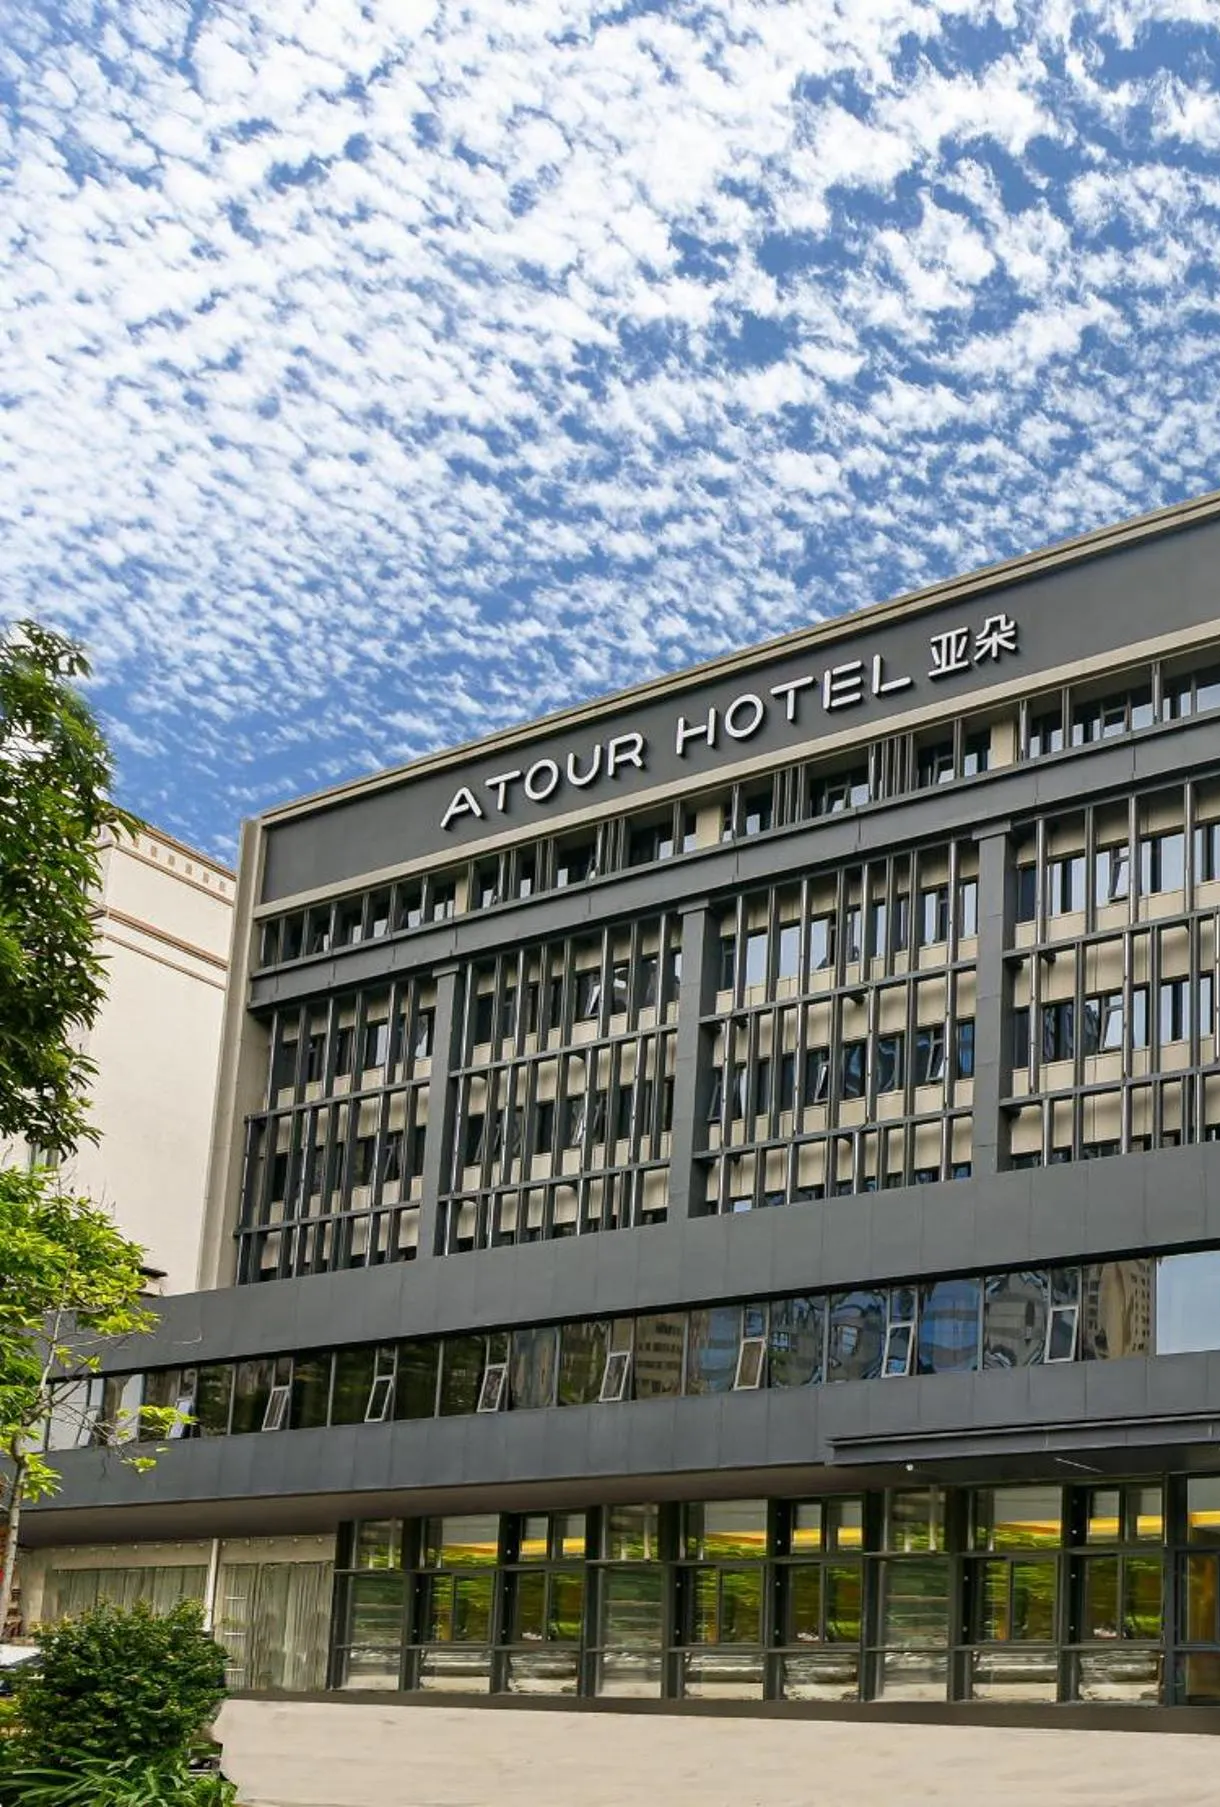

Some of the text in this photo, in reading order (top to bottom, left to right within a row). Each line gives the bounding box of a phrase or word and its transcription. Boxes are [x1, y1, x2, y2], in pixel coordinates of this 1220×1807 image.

[440, 613, 1018, 829] ATOUR HOTEL 亚朵
